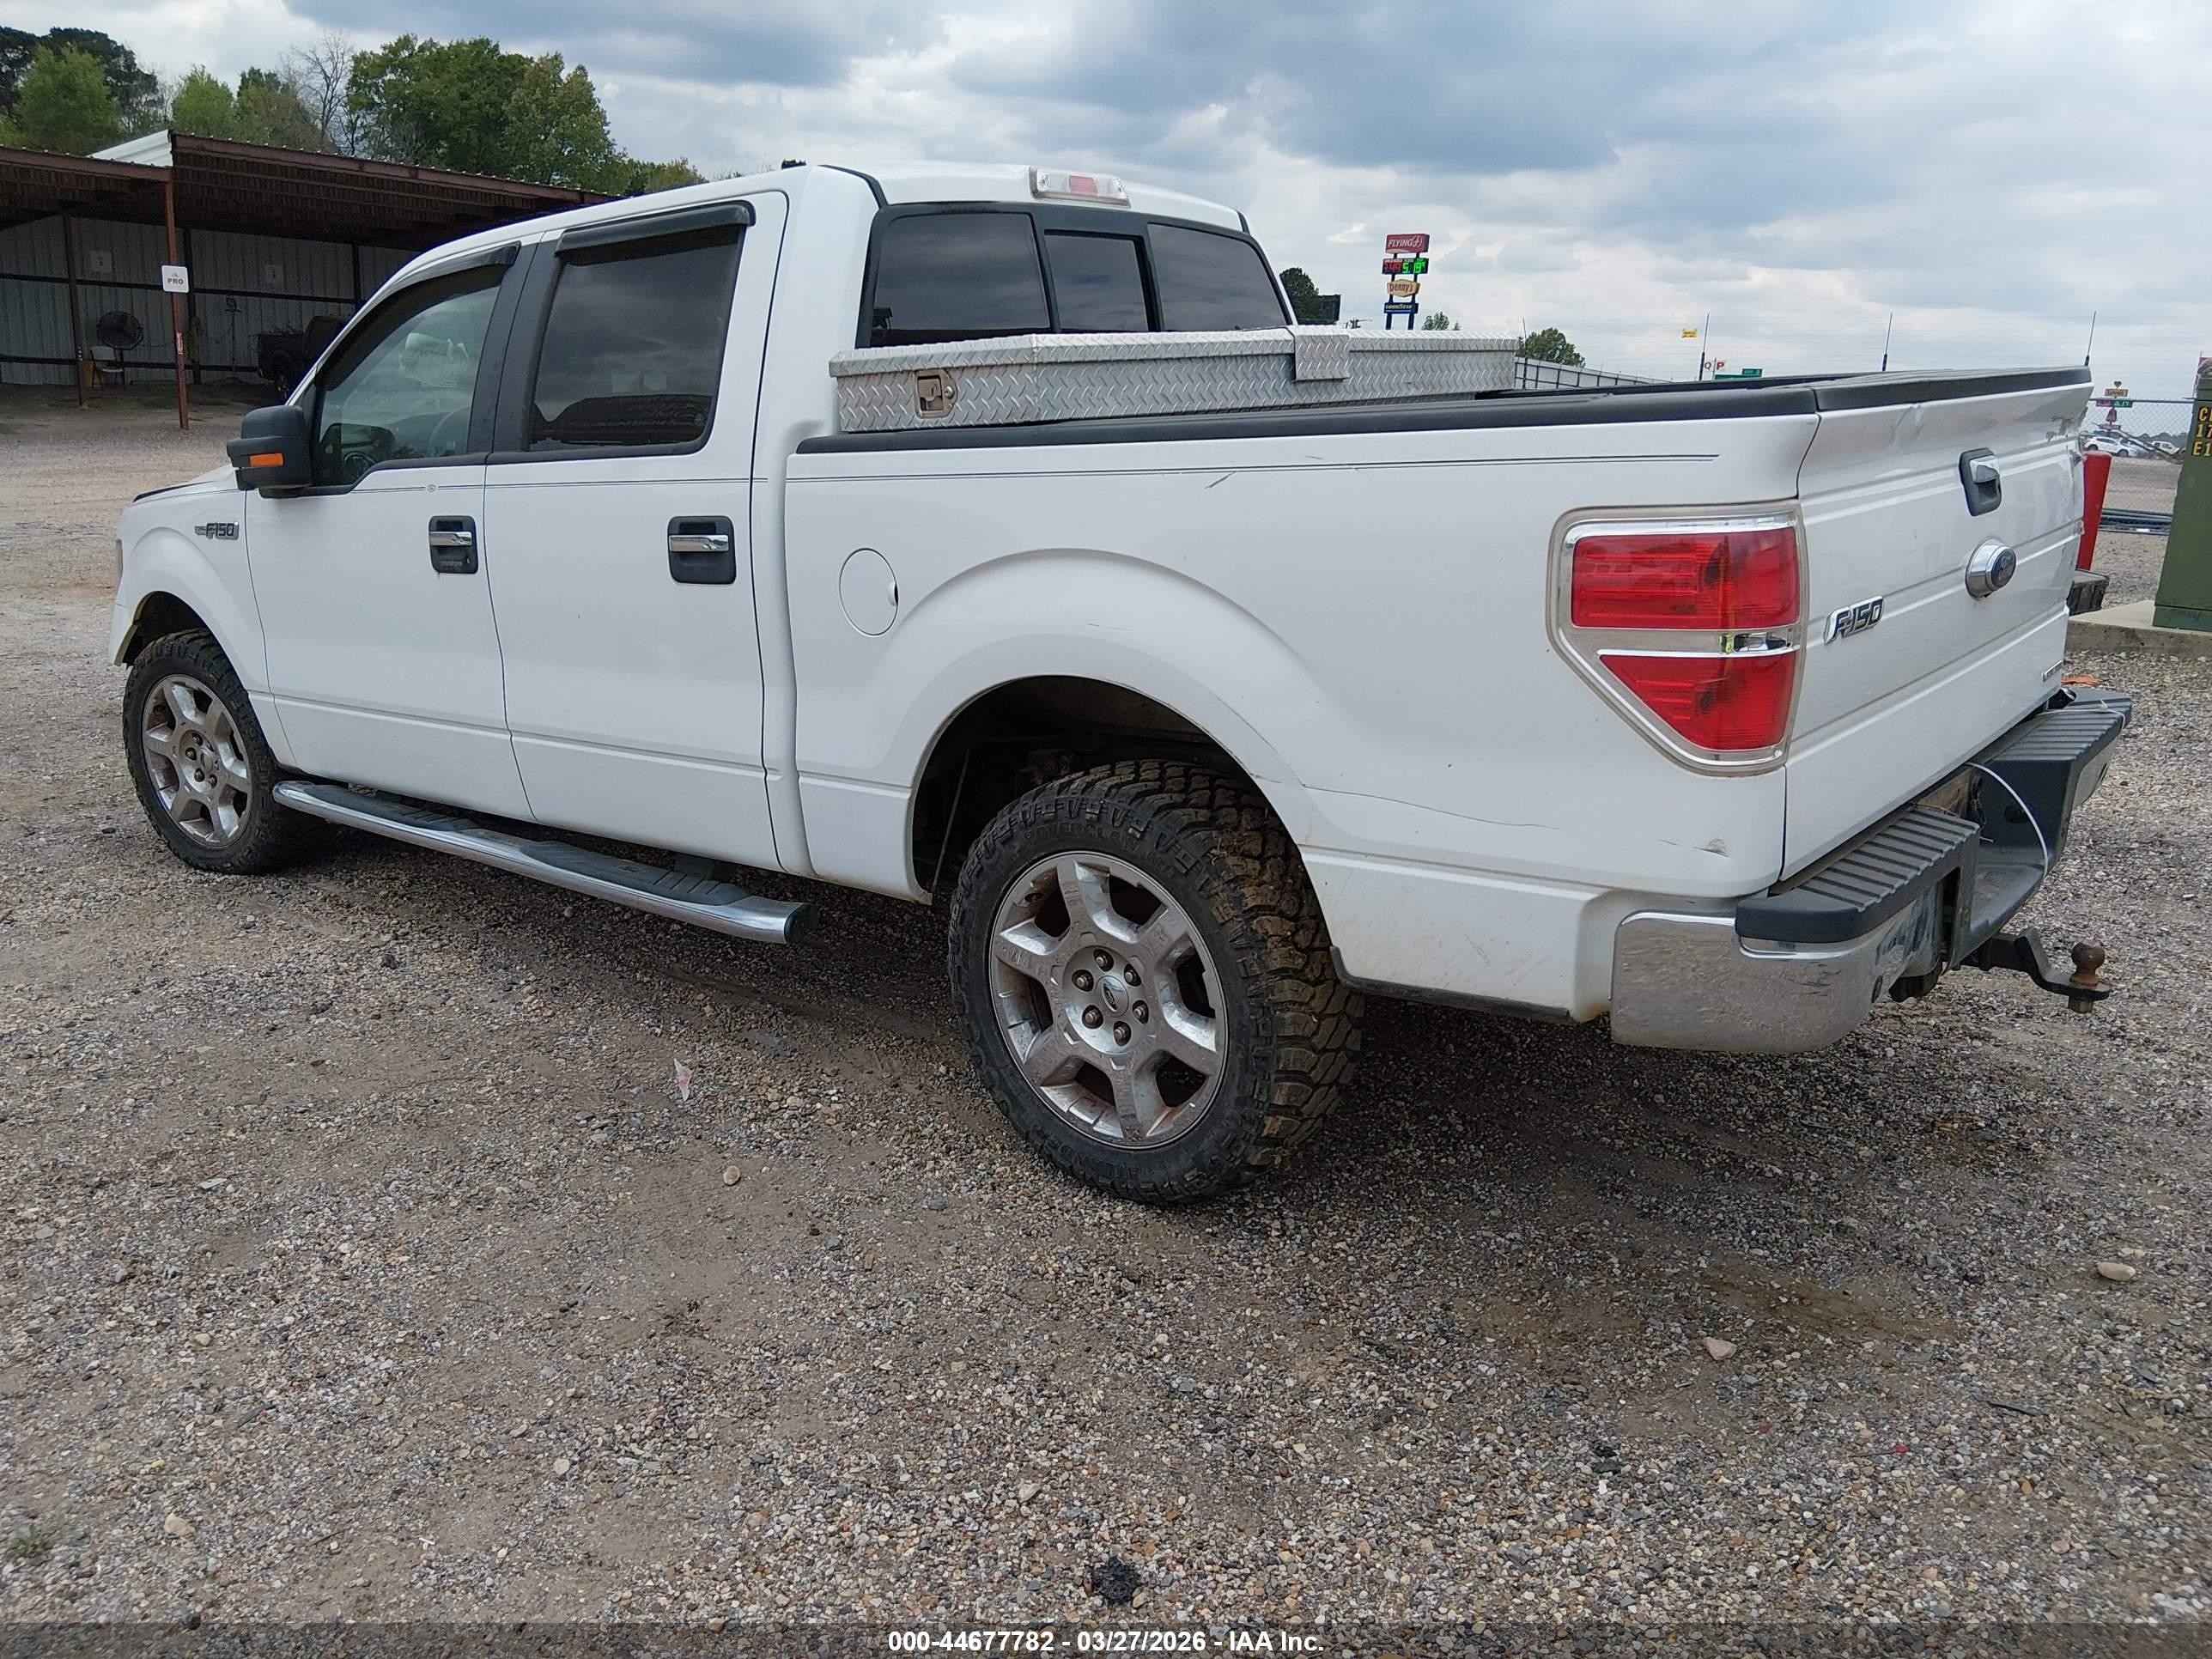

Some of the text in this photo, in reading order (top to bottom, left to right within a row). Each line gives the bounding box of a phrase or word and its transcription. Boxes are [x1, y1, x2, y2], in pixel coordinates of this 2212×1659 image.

[1387, 239, 1413, 247] FLYING
[1389, 283, 1414, 293] Denny's
[1705, 362, 1711, 370] Q
[1717, 362, 1724, 370] P
[2192, 441, 2211, 456] E1
